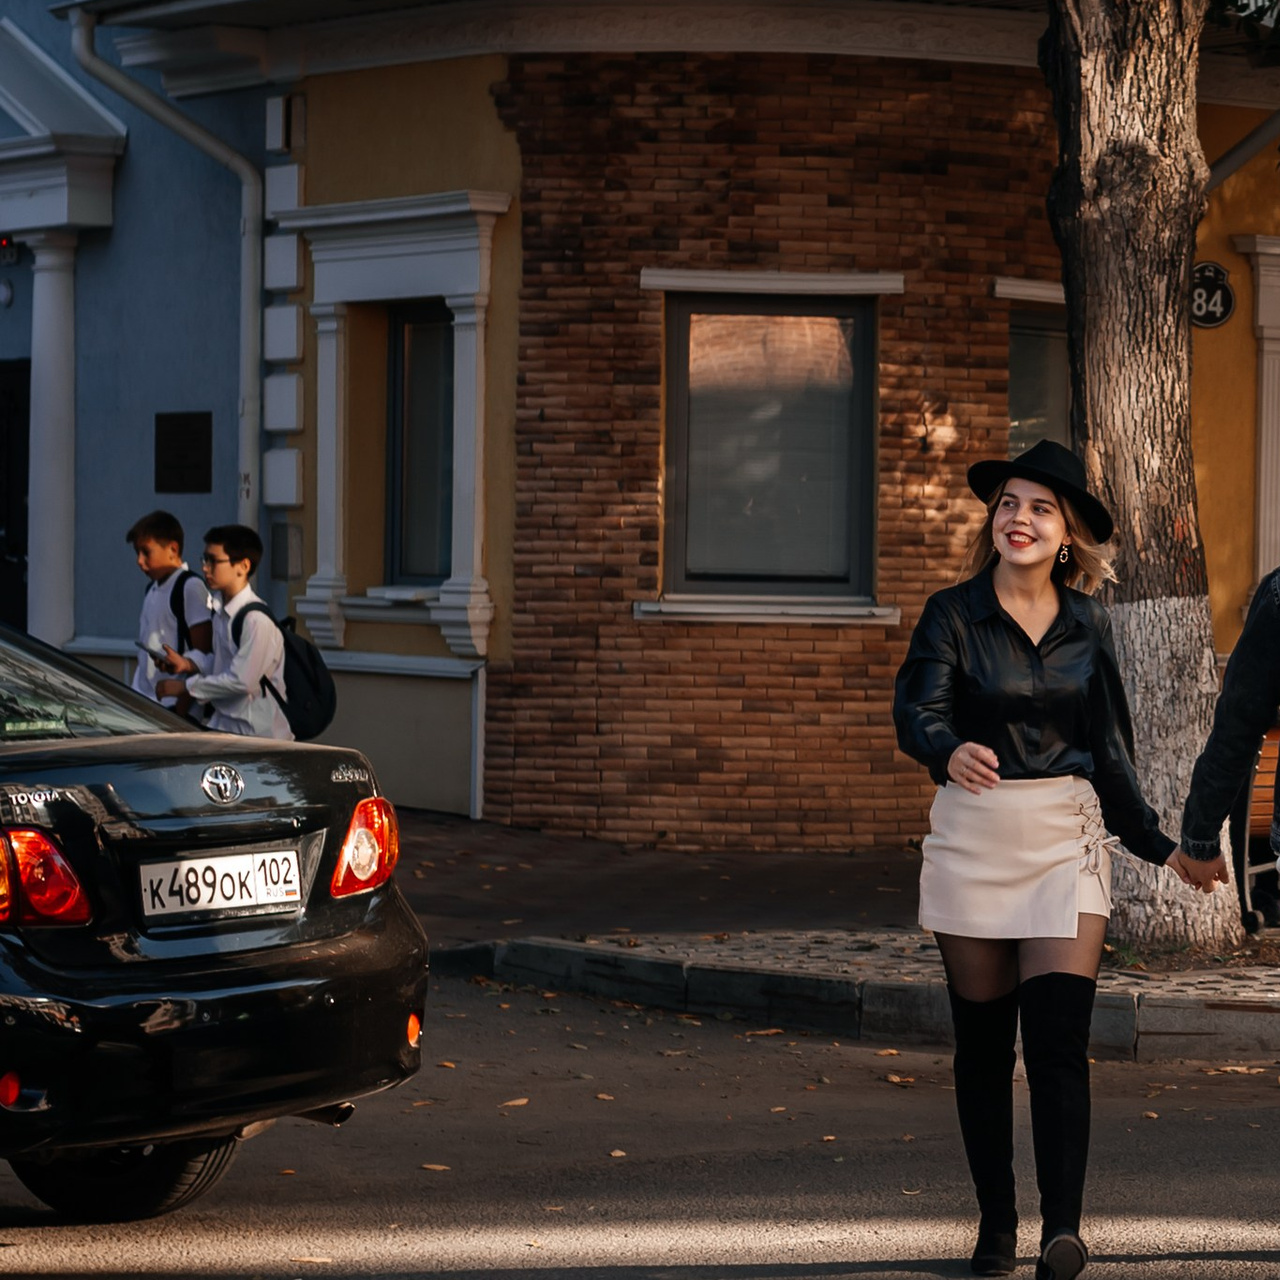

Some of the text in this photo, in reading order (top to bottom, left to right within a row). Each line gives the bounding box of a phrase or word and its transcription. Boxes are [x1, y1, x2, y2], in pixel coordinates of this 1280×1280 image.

[1193, 288, 1224, 317] 84
[8, 790, 61, 805] TOYOTA
[149, 857, 293, 909] К489ОК 102
[266, 886, 285, 898] RUS
